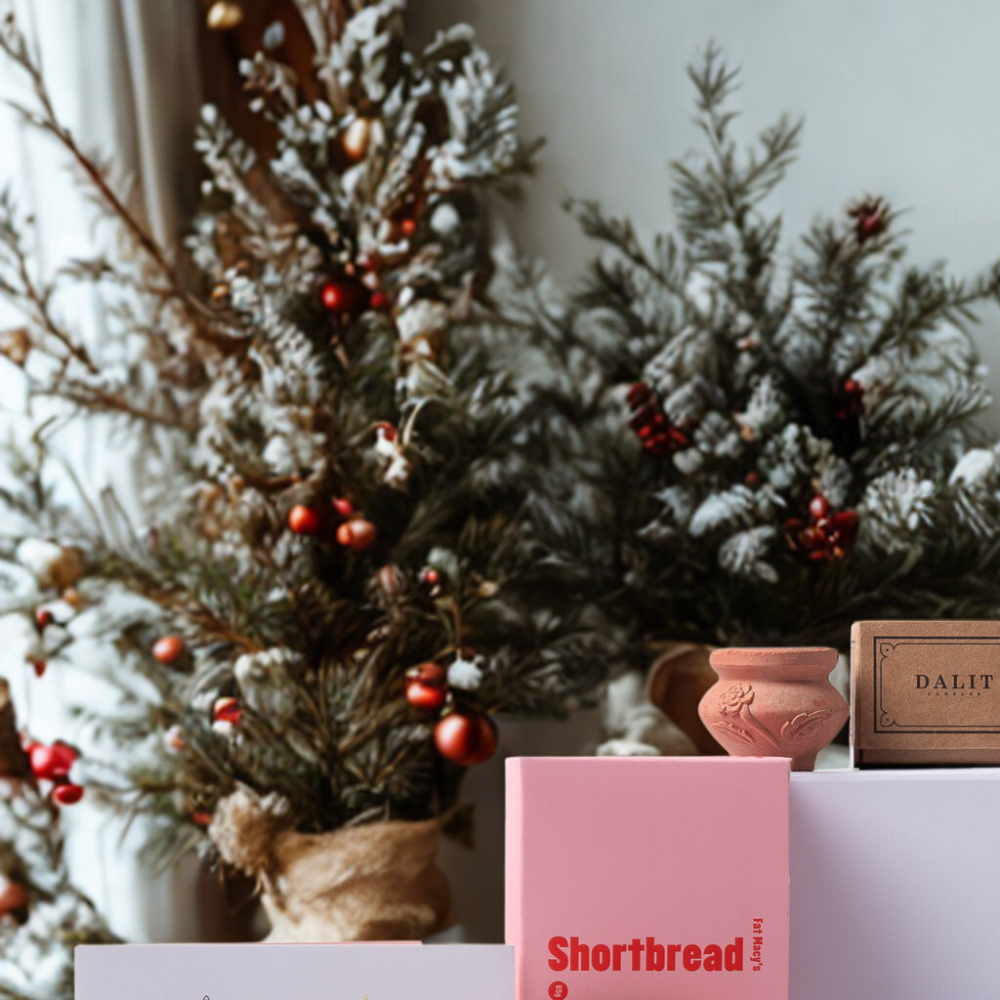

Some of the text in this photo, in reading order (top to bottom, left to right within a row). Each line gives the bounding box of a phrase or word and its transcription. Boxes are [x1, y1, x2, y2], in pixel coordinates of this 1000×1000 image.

[915, 674, 993, 690] DALIT
[548, 936, 744, 972] Shortbread
[750, 918, 764, 972] Fat Macy's
